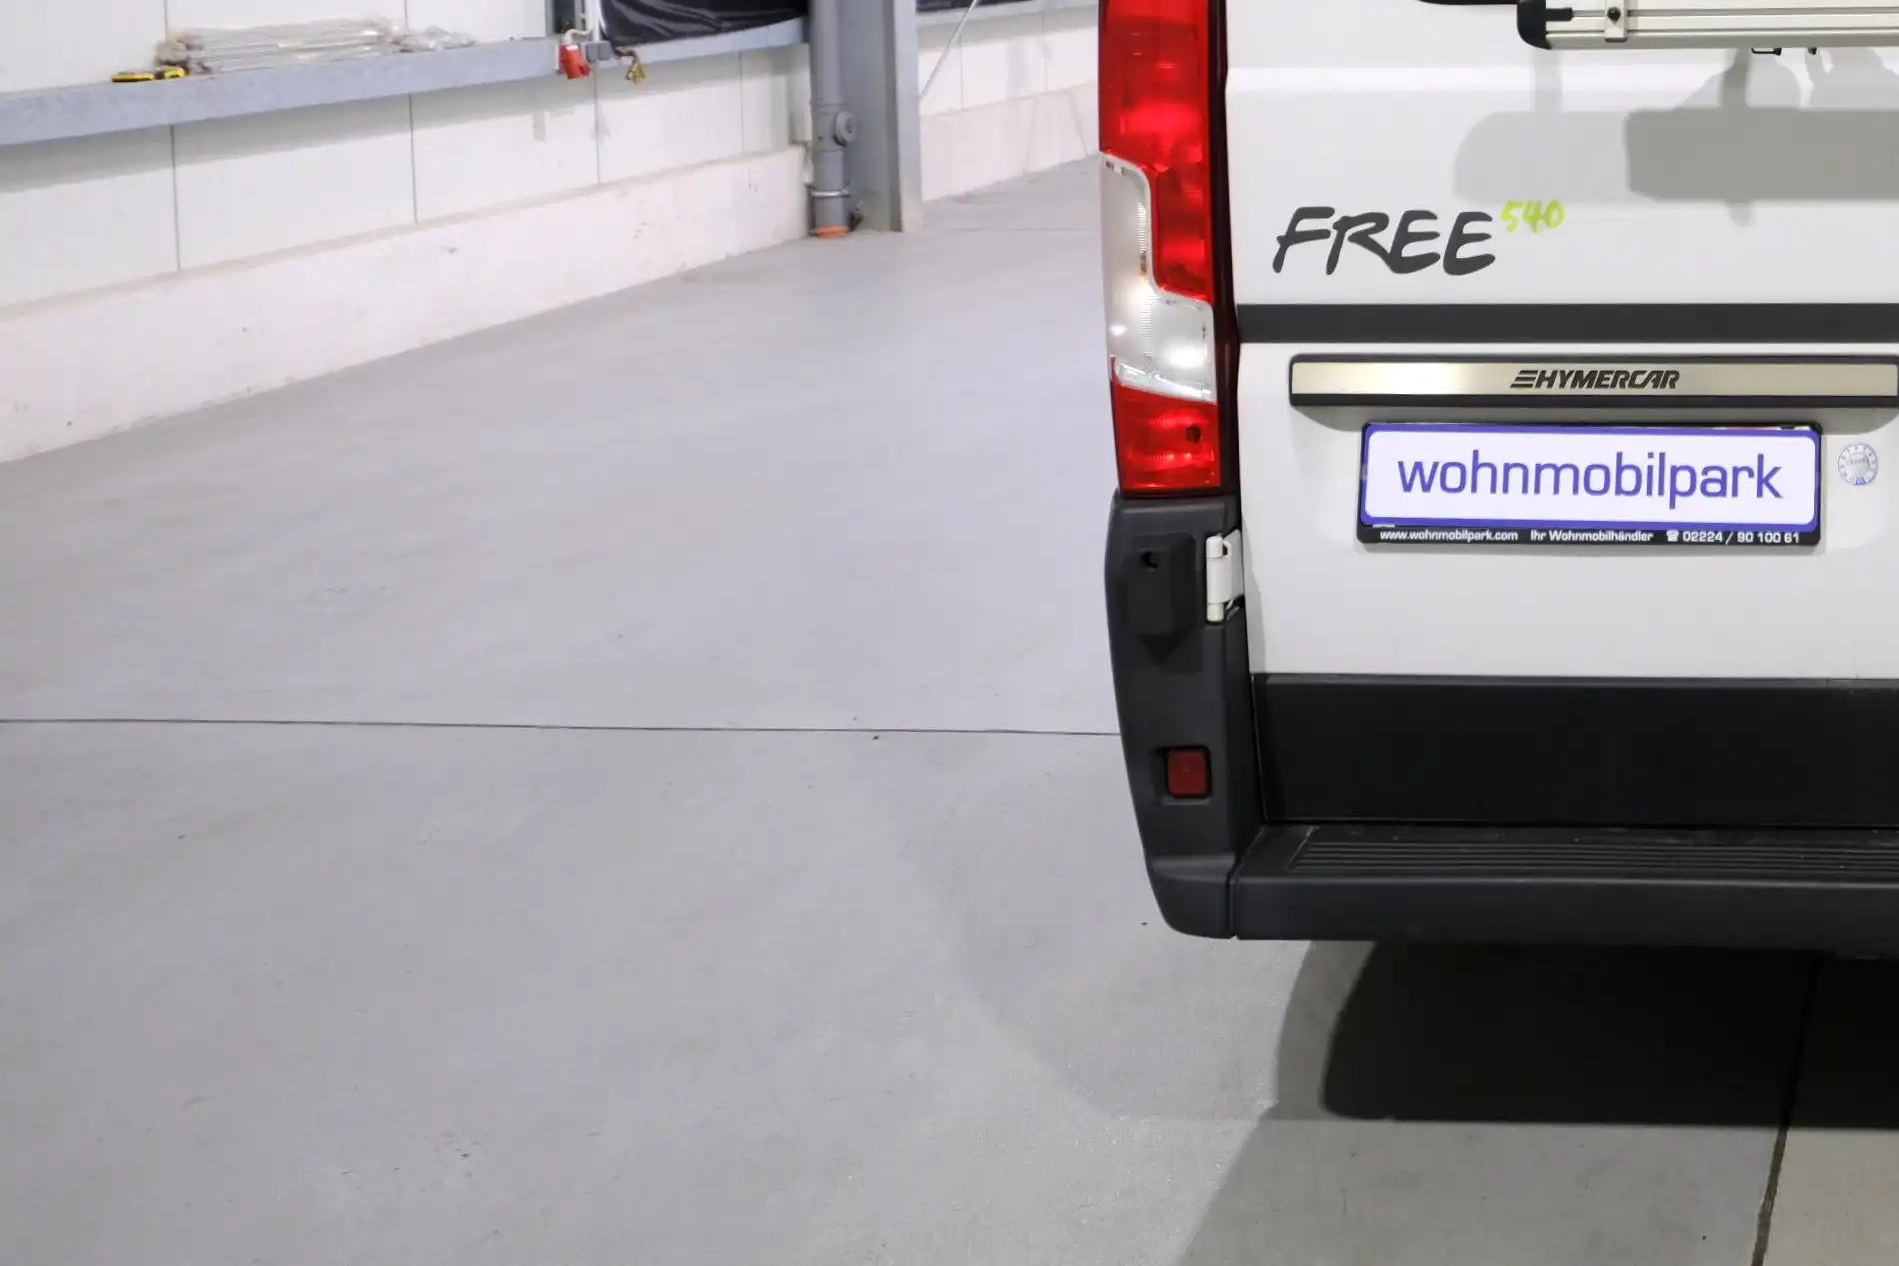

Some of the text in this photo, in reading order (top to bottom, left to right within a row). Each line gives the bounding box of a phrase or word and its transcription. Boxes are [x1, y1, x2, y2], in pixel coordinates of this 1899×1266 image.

[1272, 199, 1568, 275] FREE 540
[1533, 369, 1681, 390] HYMERCAR
[1397, 450, 1785, 510] wohnmobilpark
[1380, 529, 1519, 543] www.wohnmobilpark.com
[1530, 529, 1546, 542] Ihr
[1549, 529, 1654, 542] Wohnmobilhändler
[1682, 530, 1723, 543] 02224
[1737, 531, 1754, 543] 90
[1758, 531, 1781, 544] 100
[1784, 531, 1800, 544] 61
